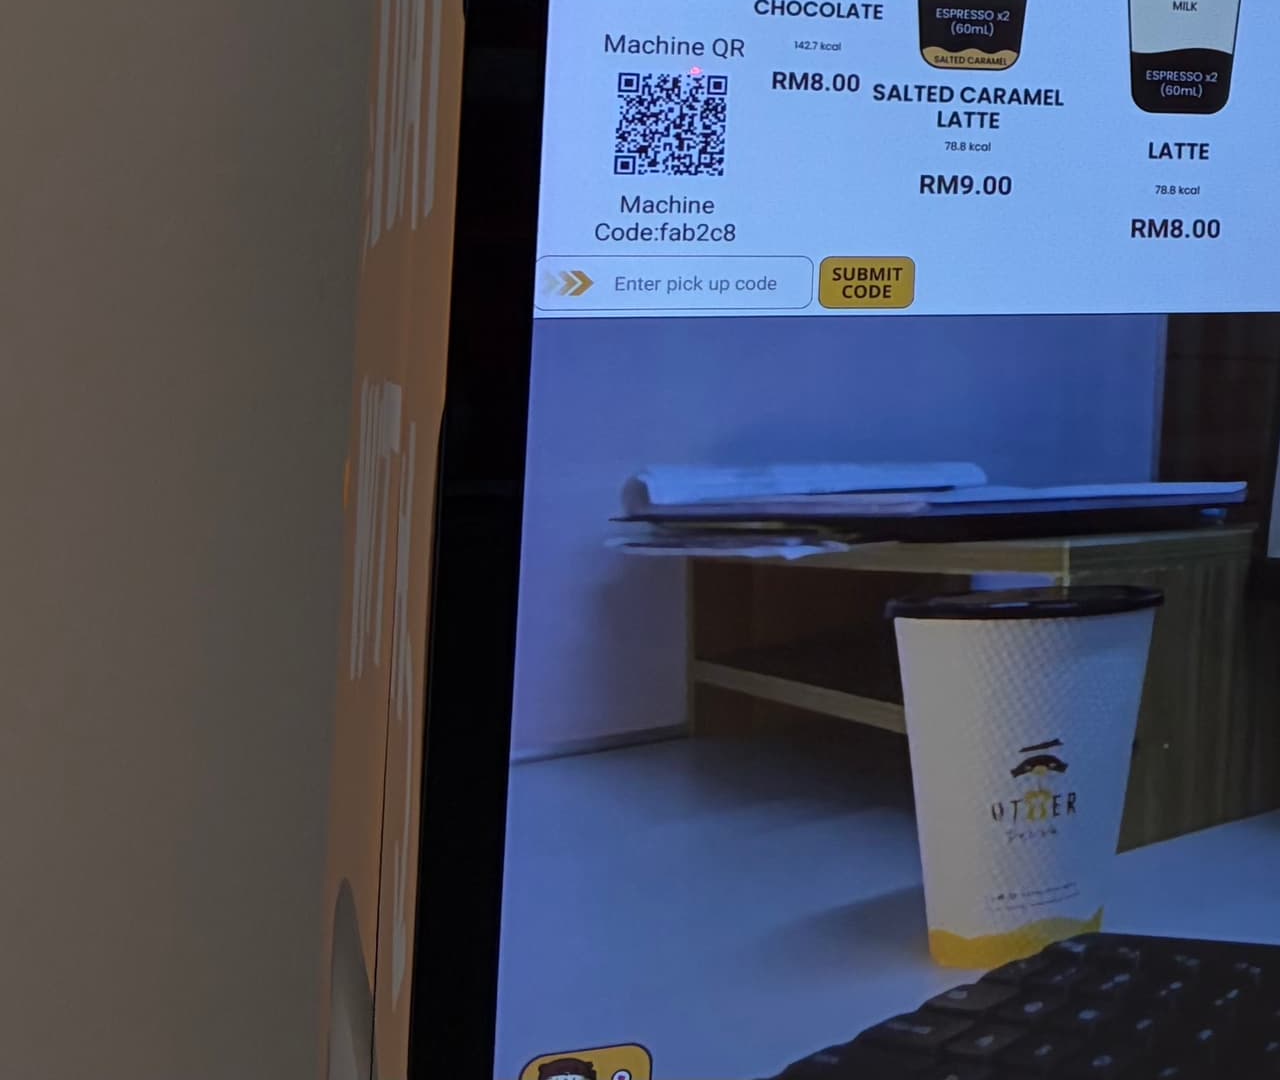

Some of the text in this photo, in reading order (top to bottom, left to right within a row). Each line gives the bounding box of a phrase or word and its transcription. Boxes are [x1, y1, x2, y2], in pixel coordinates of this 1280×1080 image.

[754, 0, 884, 20] CHOCOLATE
[936, 8, 1010, 21] ESPRESSO x2
[1172, 0, 1197, 12] MILK
[950, 22, 995, 37] (60mL)
[604, 33, 745, 58] Machine QR
[934, 55, 1007, 66] SALTED CARAMEL
[771, 71, 860, 92] RM8.00
[1145, 70, 1218, 82] ESPRESSO x2
[872, 84, 1064, 106] SALTED CARAMEL
[1160, 83, 1203, 97] (60mL)
[937, 110, 1000, 129] LATTE
[1148, 142, 1209, 160] LATTE
[919, 174, 1012, 195] RM9.00
[620, 195, 715, 214] Machine
[594, 223, 736, 243] Code:fab2c8
[1130, 218, 1221, 238] RM8.00
[832, 267, 903, 282] SUBMIT
[614, 276, 777, 295] Enter pick up code
[841, 284, 892, 299] CODE
[350, 375, 417, 722] WITH
